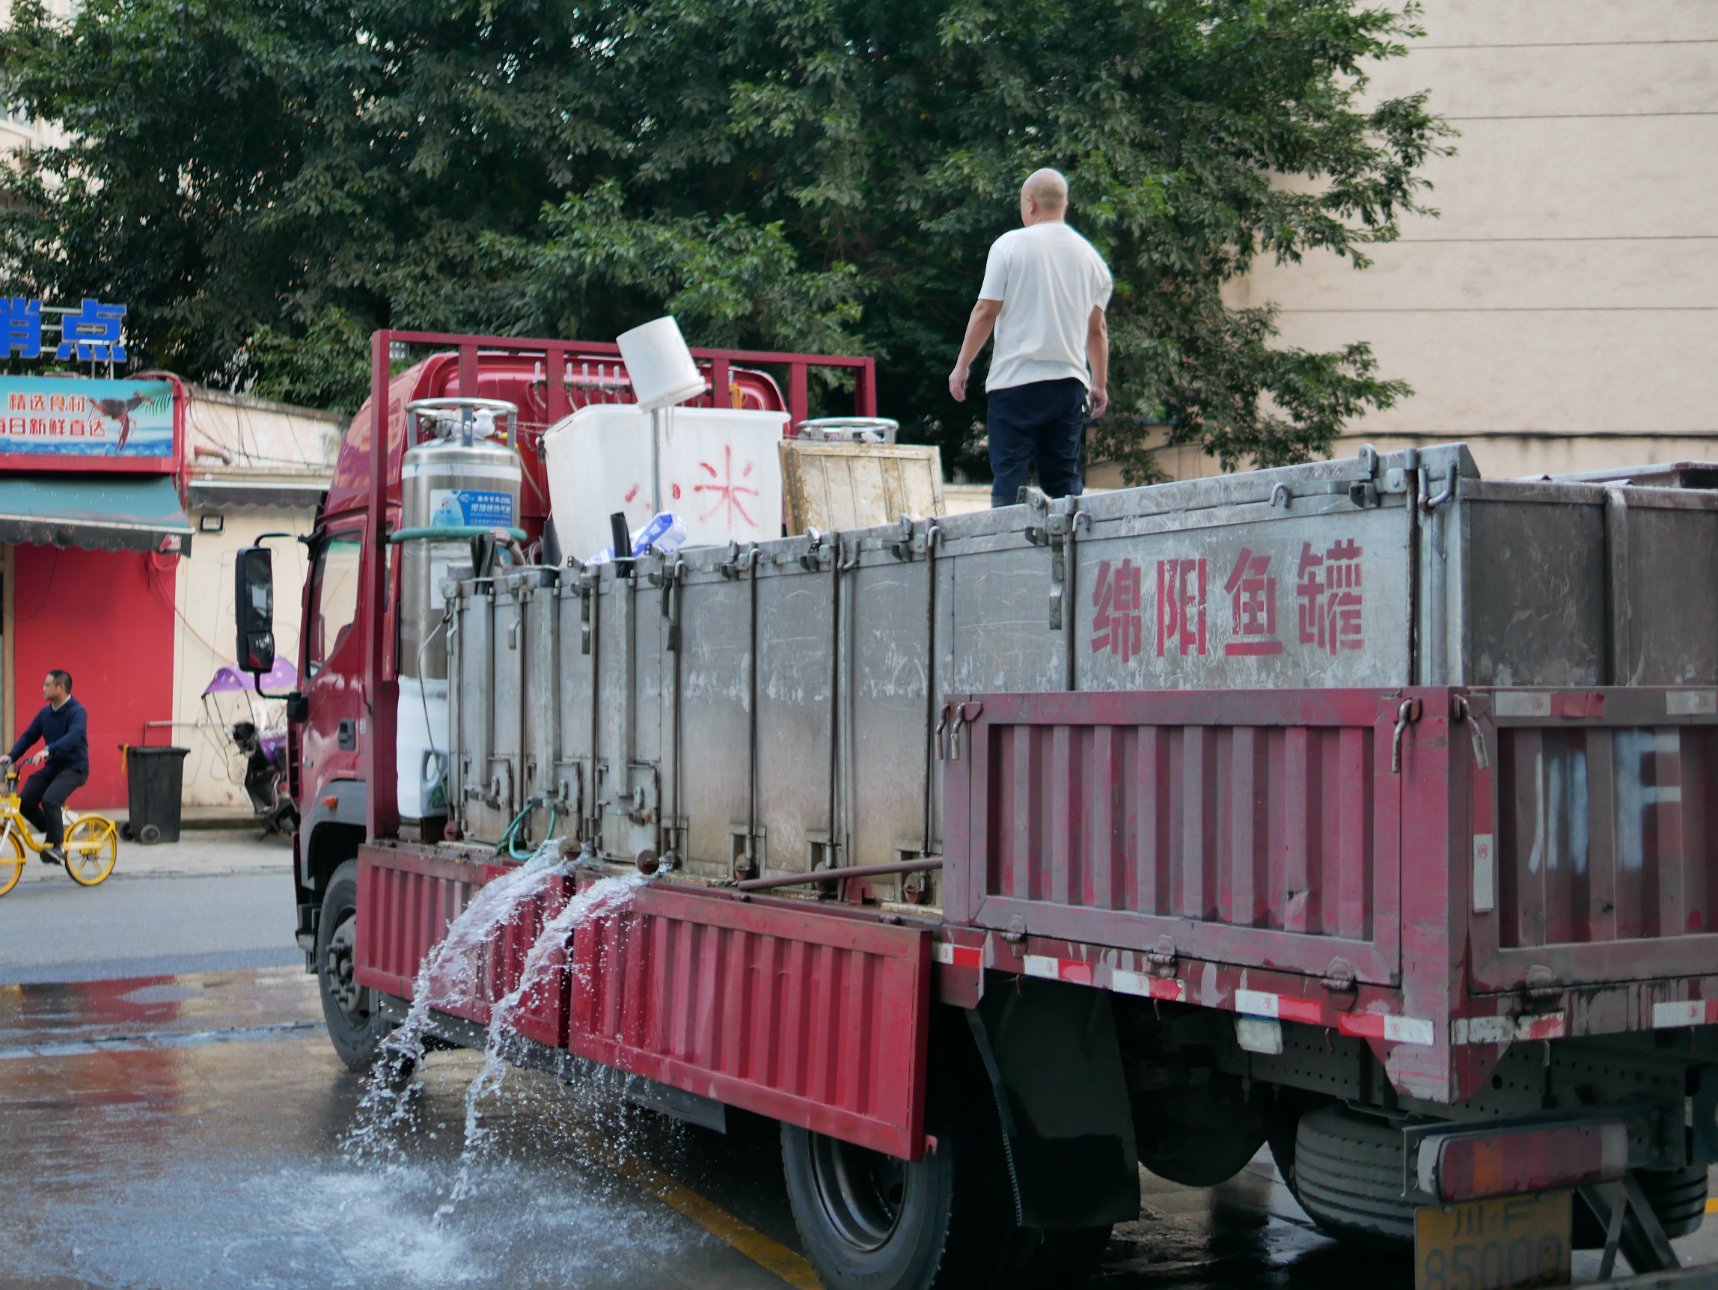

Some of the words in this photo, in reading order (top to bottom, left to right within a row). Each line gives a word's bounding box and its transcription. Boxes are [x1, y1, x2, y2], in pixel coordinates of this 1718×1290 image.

[9, 392, 86, 413] 精选食材
[1091, 538, 1364, 663] 绵阳鱼罐
